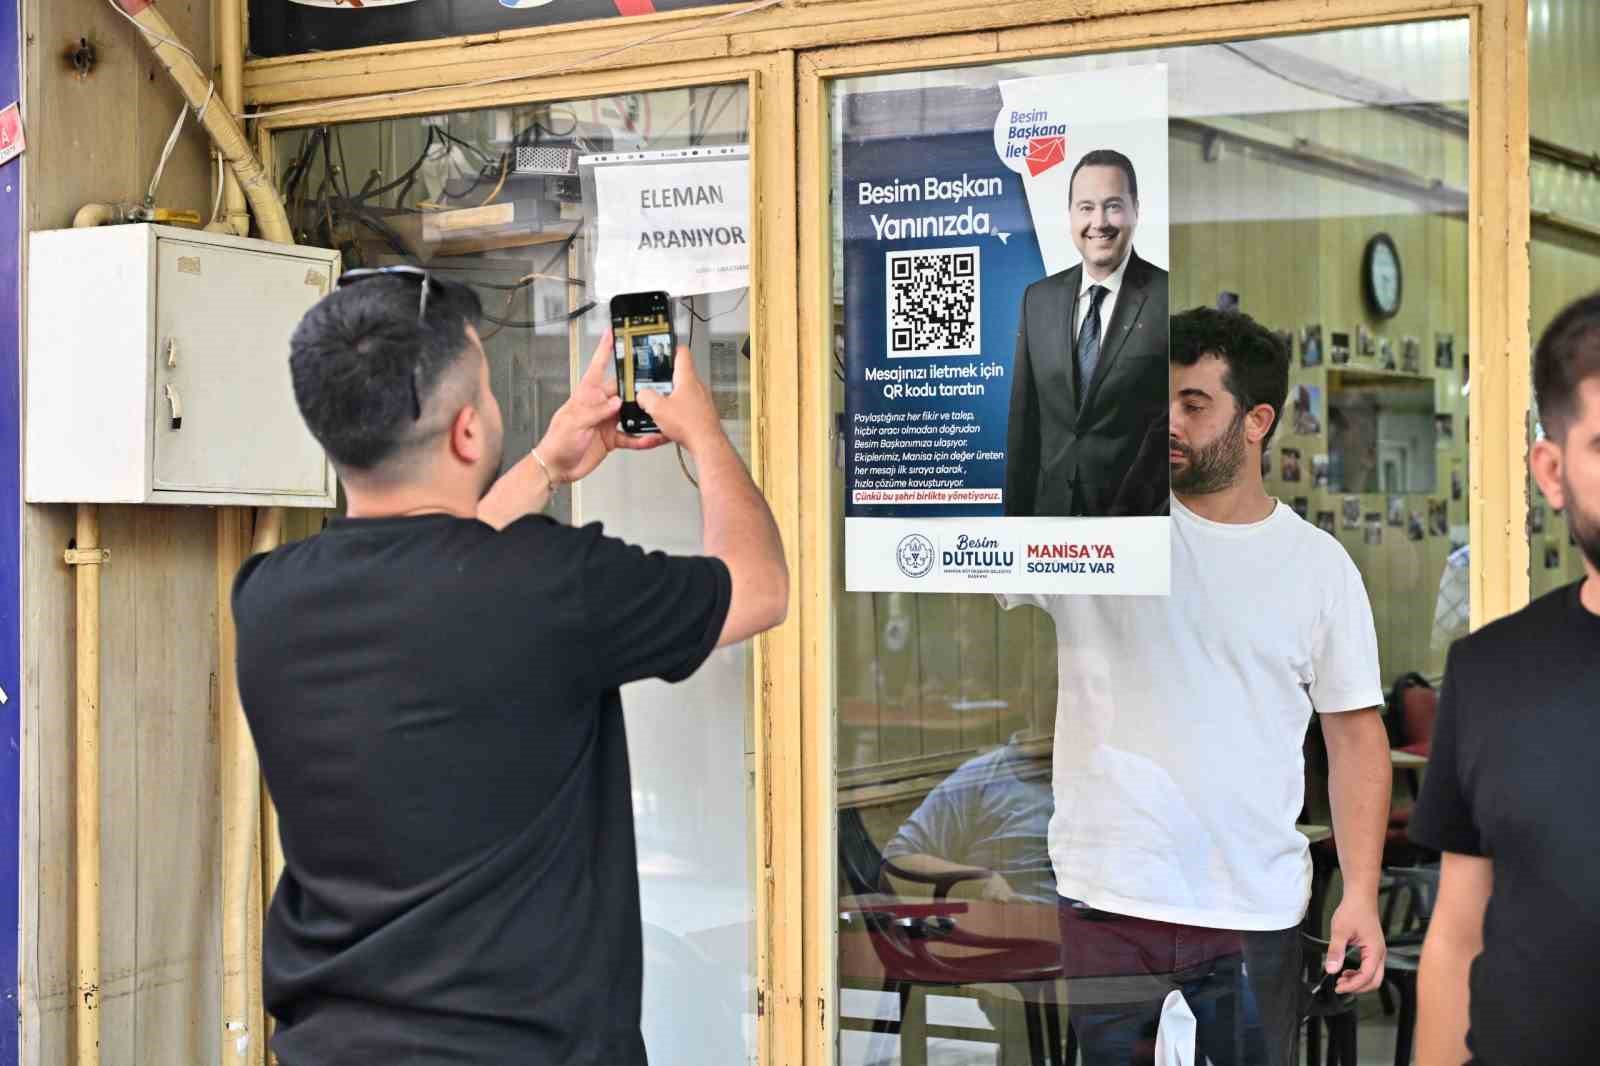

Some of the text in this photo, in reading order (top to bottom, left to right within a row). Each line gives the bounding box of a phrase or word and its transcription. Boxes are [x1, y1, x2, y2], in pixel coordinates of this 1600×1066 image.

[1010, 108, 1048, 124] Besim
[1008, 124, 1066, 138] Başkana
[1006, 144, 1027, 158] İlet
[859, 174, 1002, 204] Besim Başkan
[640, 185, 724, 208] ELEMAN
[870, 207, 990, 240] Yanınızda
[638, 226, 746, 250] ARANIYOR
[864, 363, 1004, 382] Mesajınızı iletmek için
[883, 383, 985, 400] QR kodu taratın
[854, 412, 905, 423] Paylaştığınız
[906, 412, 921, 421] her
[922, 412, 938, 420] fikir
[854, 424, 981, 436] hiçbir aracı olmadan doğrudan
[854, 440, 878, 449] Besim
[880, 439, 932, 450] Başkanımıza
[854, 450, 1004, 463] Ekiplerimiz, Manisa için değer üreten
[854, 466, 868, 475] her
[870, 466, 896, 476] mesajı
[898, 465, 906, 474] ilk
[908, 465, 934, 476] sıraya
[854, 479, 874, 488] hızla
[874, 478, 908, 488] çözüme
[855, 490, 1000, 502] Çünkü bu şehri birlikte yönetiyoruz.
[956, 534, 999, 550] Besim
[1026, 542, 1115, 558] MANİSA'YA
[942, 551, 1014, 566] DUTLULU
[1026, 560, 1086, 574] SÖZÜMÜZ
[1089, 562, 1115, 574] VAR
